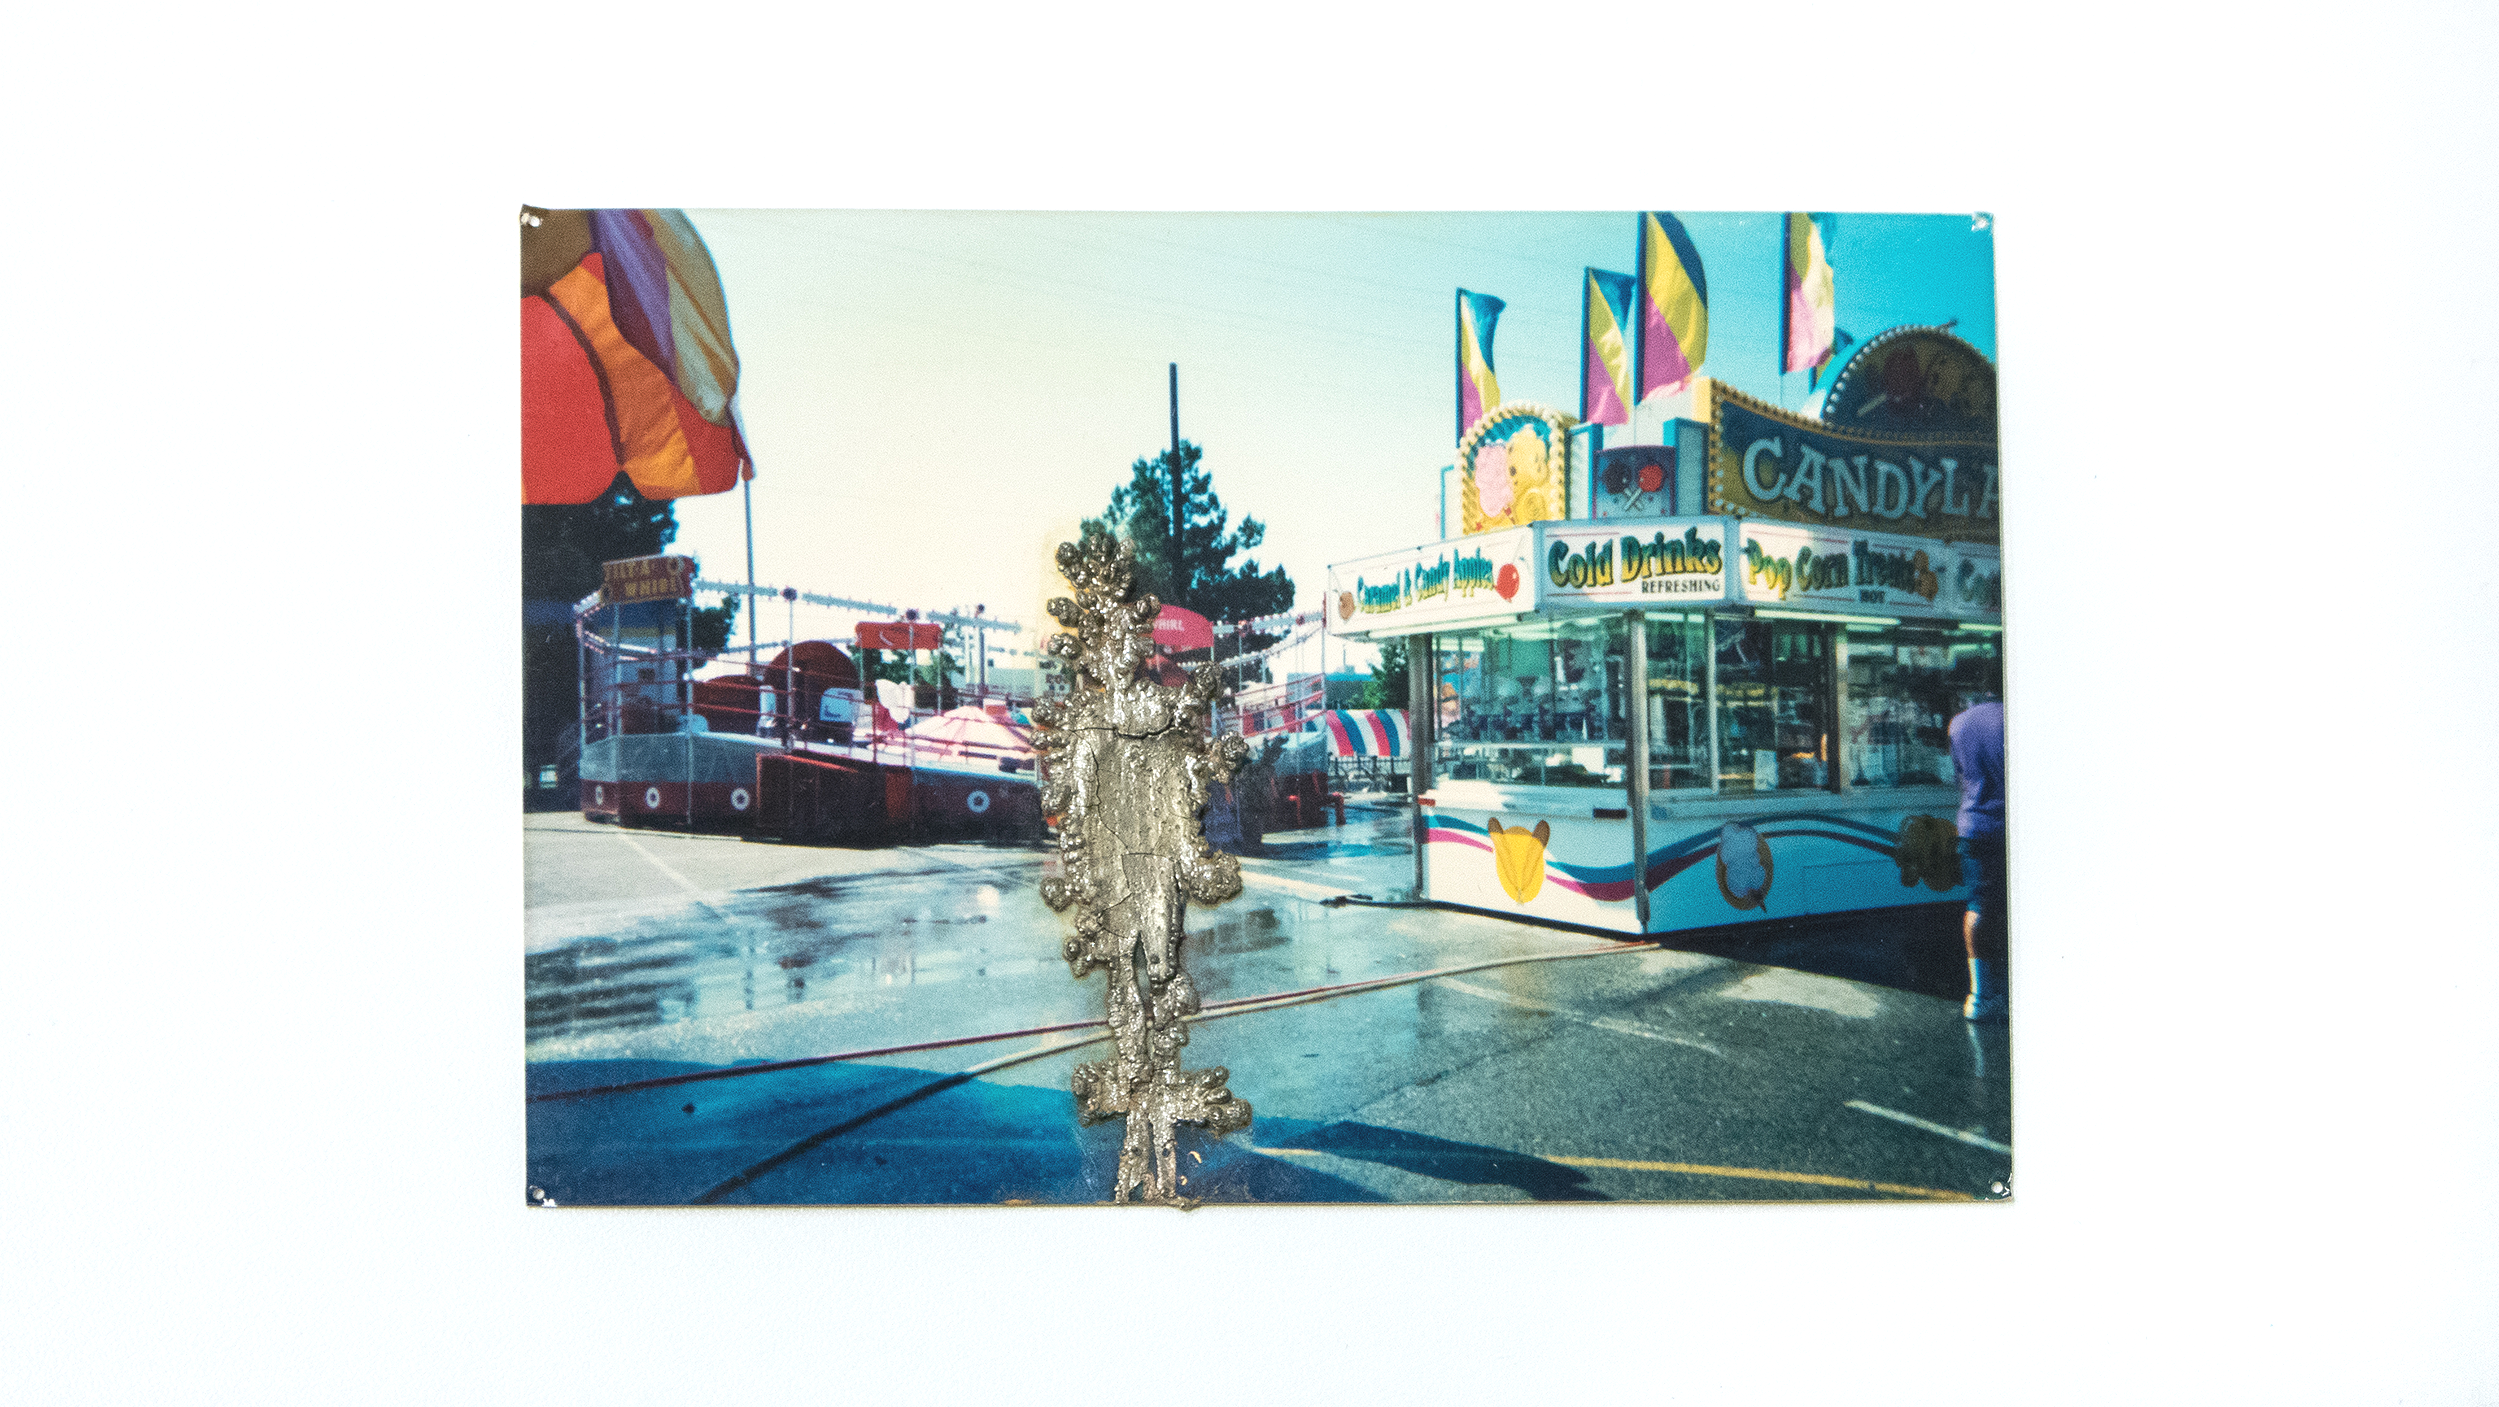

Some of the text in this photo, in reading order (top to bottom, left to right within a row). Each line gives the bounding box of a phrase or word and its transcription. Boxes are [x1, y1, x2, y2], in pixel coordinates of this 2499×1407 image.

[1415, 552, 1451, 602] Candy
[1453, 546, 1494, 598] Apples
[1548, 526, 1723, 589] Cold Drinks
[1641, 578, 1721, 594] REFRESHING
[1745, 538, 1793, 600] Pop
[1796, 545, 1849, 592] Corn
